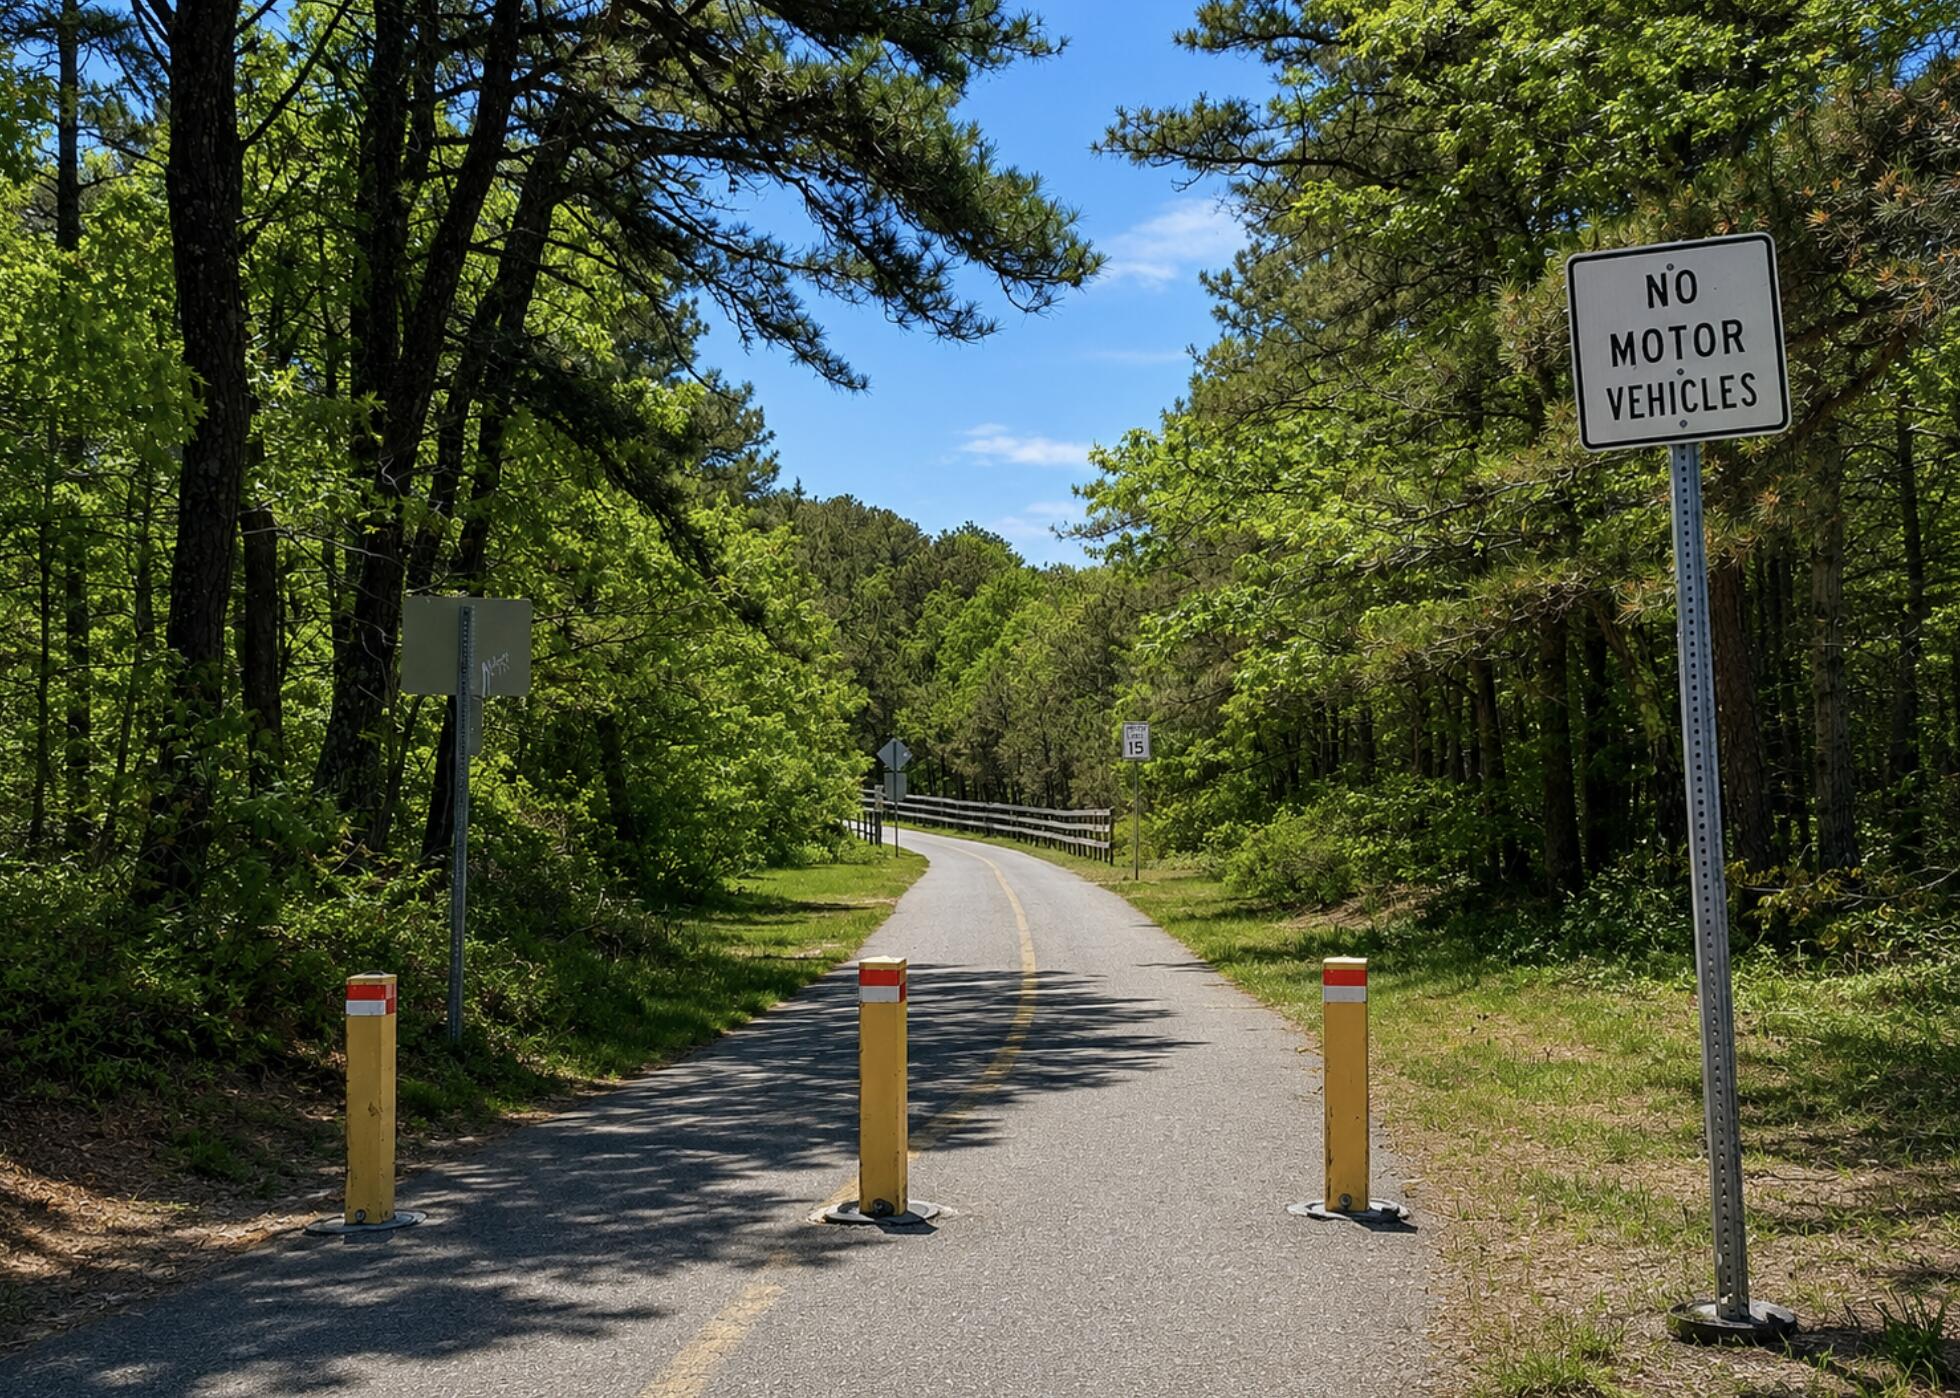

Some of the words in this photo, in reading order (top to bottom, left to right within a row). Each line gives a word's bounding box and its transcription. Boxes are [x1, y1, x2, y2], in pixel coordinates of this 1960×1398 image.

[1646, 269, 1698, 309] NO
[1609, 319, 1746, 368] MOTOR
[1606, 372, 1758, 421] VEHICLES
[1129, 741, 1145, 755] 15
